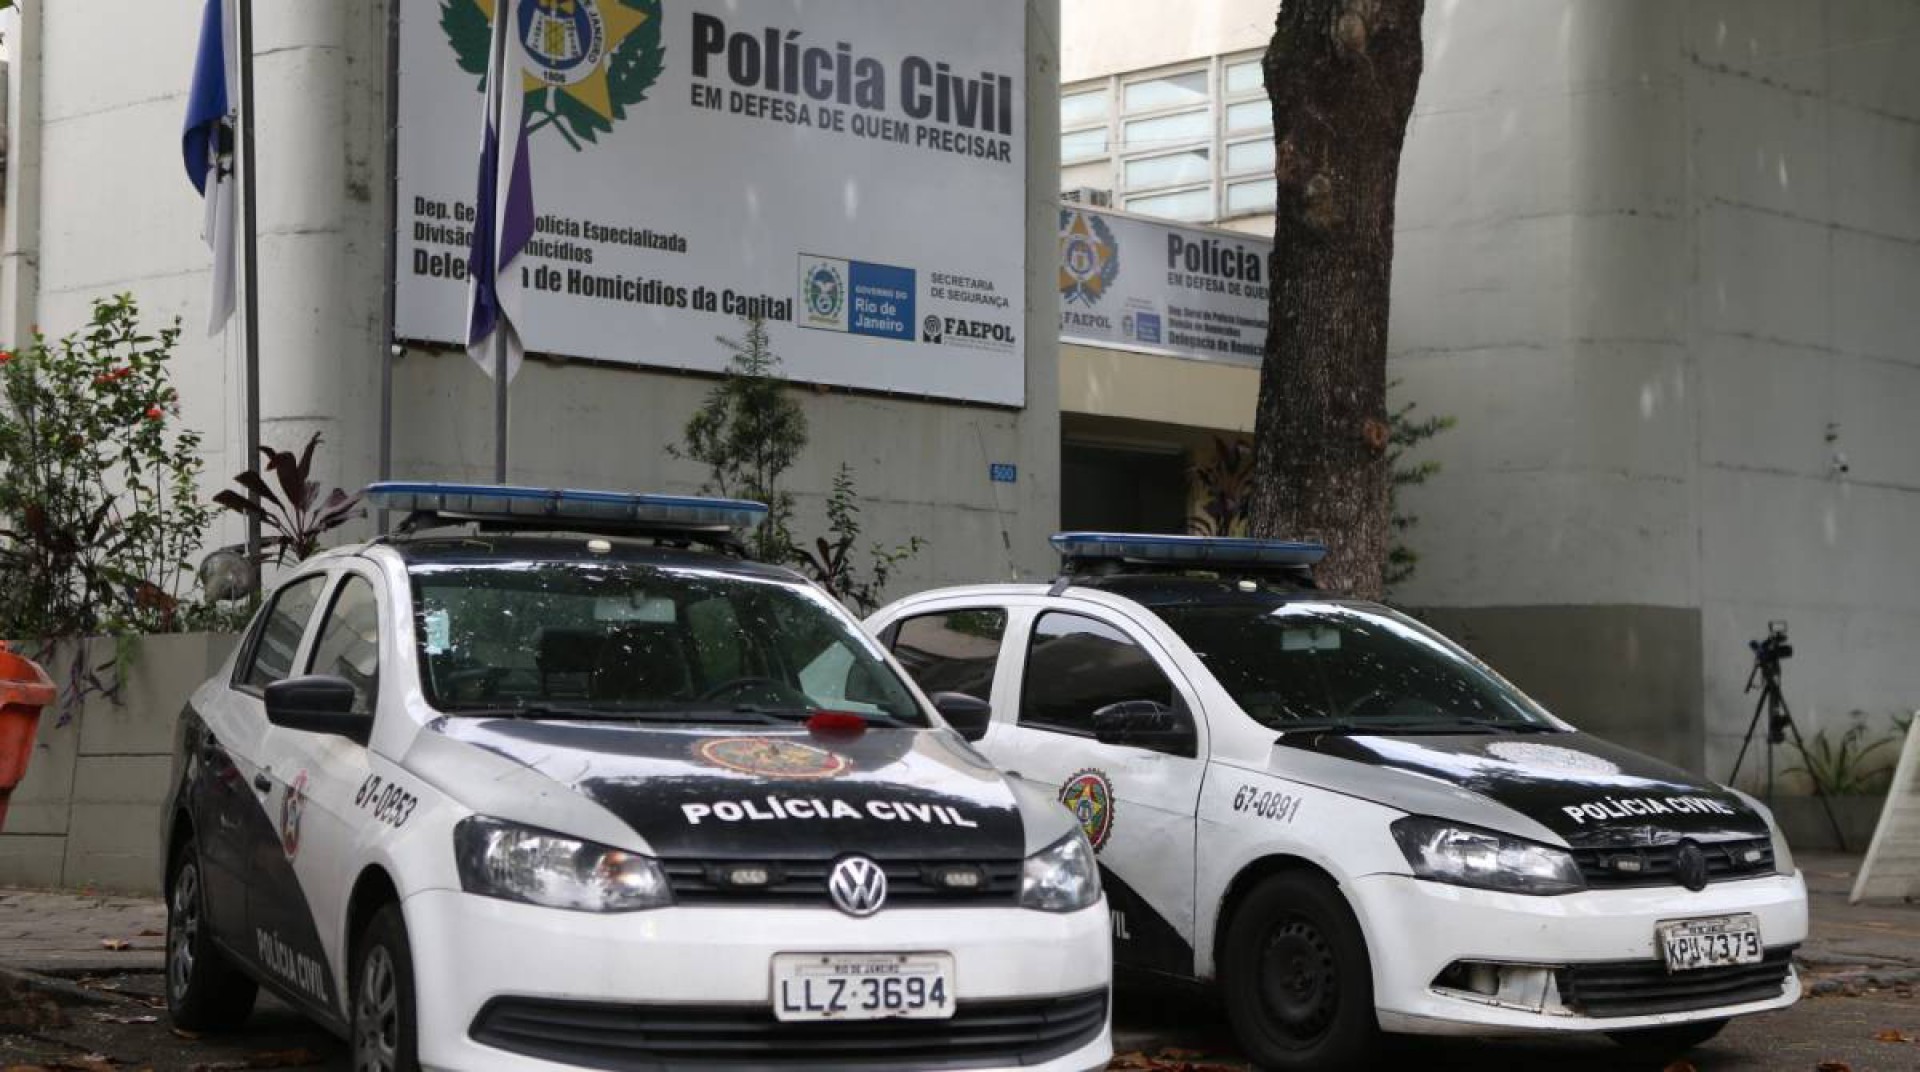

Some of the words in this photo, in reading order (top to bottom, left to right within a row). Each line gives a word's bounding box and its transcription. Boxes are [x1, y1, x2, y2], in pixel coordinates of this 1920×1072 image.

[692, 12, 885, 111] Polícia
[901, 56, 1012, 136] Civil
[691, 83, 722, 111] EM
[730, 91, 811, 127] DEFESA
[818, 107, 845, 133] DE
[852, 113, 909, 145] QUEM
[916, 126, 1012, 163] PRECISAR
[414, 195, 451, 219] Dep.
[536, 215, 580, 238] olícia
[584, 219, 687, 253] Especializada
[525, 237, 593, 264] micídios
[1167, 232, 1261, 282] Polícia
[535, 265, 562, 292] de
[567, 268, 688, 308] Homicídios
[692, 286, 717, 312] da
[722, 289, 793, 322] Capital
[931, 272, 994, 291] SECRETARIA
[1168, 272, 1183, 287] EM
[1186, 274, 1226, 294] DEFESA
[1228, 280, 1243, 295] DE
[856, 298, 878, 314] Rio
[880, 301, 897, 316] de
[931, 286, 945, 299] DE
[947, 288, 1009, 310] SEGURANÇA
[855, 313, 904, 332] Janeiro
[944, 317, 1016, 343] FAEPOL
[1063, 311, 1112, 330] FAEPOL
[682, 796, 863, 825] POLÍCIA
[867, 800, 978, 828] CIVIL
[1233, 784, 1302, 825] 67-0891
[1561, 796, 1670, 824] POLÍCIA
[1671, 797, 1735, 815] CIVIL
